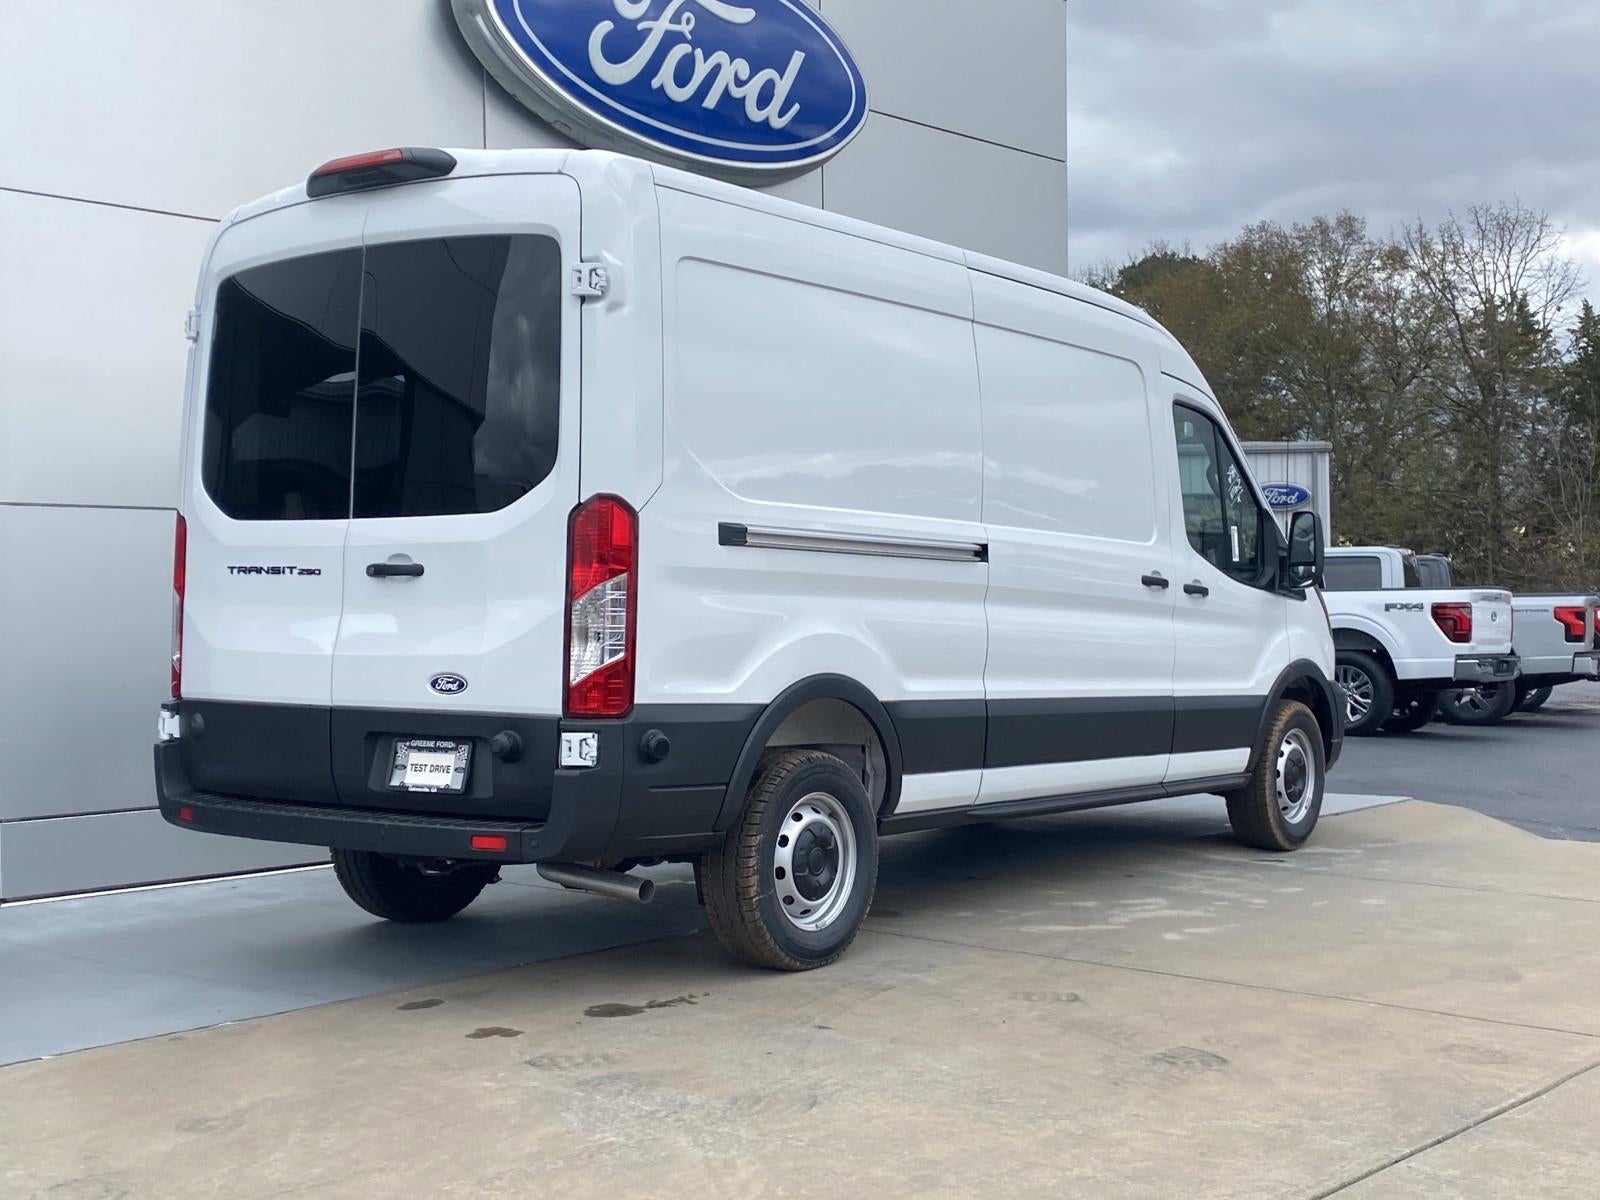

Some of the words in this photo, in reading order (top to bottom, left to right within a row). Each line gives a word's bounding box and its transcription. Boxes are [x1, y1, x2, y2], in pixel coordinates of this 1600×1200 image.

[588, 0, 806, 129] Ford
[1264, 487, 1299, 504] Ford
[227, 566, 297, 575] TRANSIT
[297, 568, 321, 576] 250
[1384, 602, 1424, 612] FX4
[435, 677, 460, 690] Ford
[410, 739, 435, 748] GREENE
[436, 740, 454, 749] FORD
[410, 763, 428, 773] TEST
[429, 764, 452, 774] DRIVE
